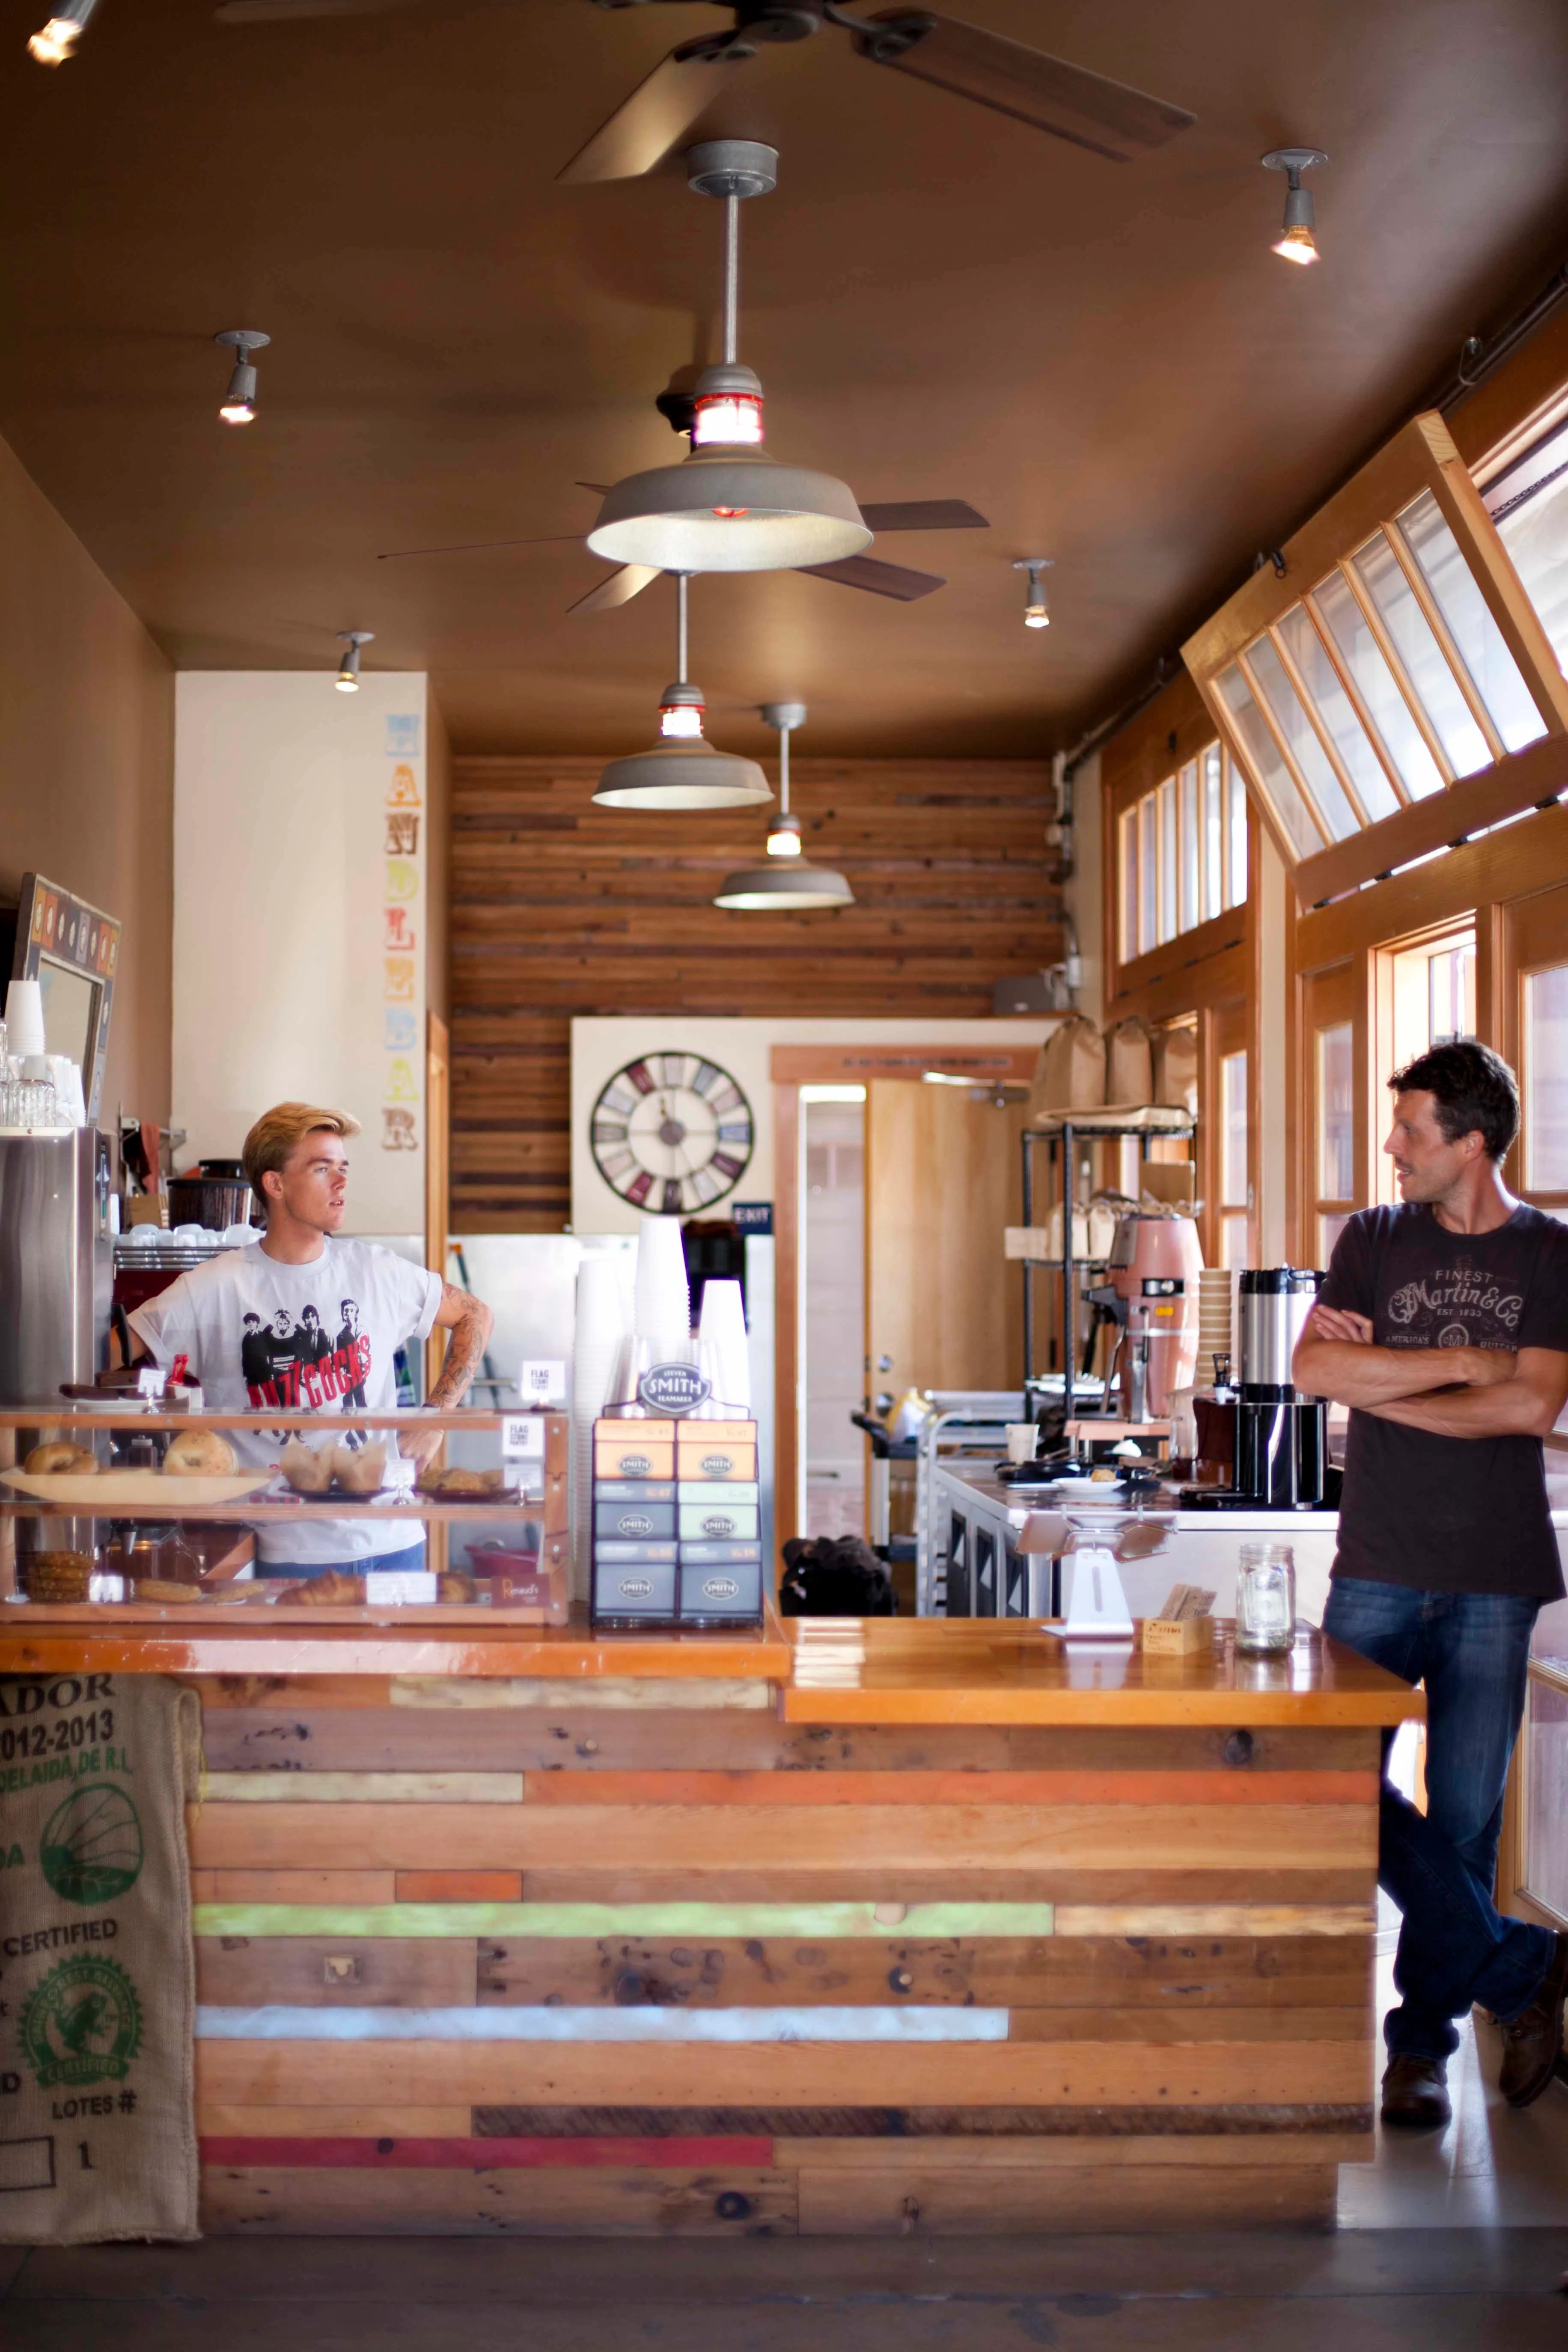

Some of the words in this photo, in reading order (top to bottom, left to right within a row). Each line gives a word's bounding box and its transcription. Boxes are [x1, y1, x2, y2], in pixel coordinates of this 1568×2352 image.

[734, 1207, 769, 1224] EXIT
[1435, 1270, 1494, 1283] FINEST
[530, 1370, 549, 1378] FLAG
[649, 1378, 702, 1395] SMITH
[510, 1425, 529, 1433] FLAG
[622, 1521, 649, 1529] SMITH
[706, 1522, 732, 1530] SMITH
[623, 1583, 650, 1592] SMITH
[707, 1584, 735, 1592] SMITH
[3, 1918, 118, 1956] CERTIFIED
[52, 2095, 113, 2119] LOTES
[119, 2089, 137, 2114] #
